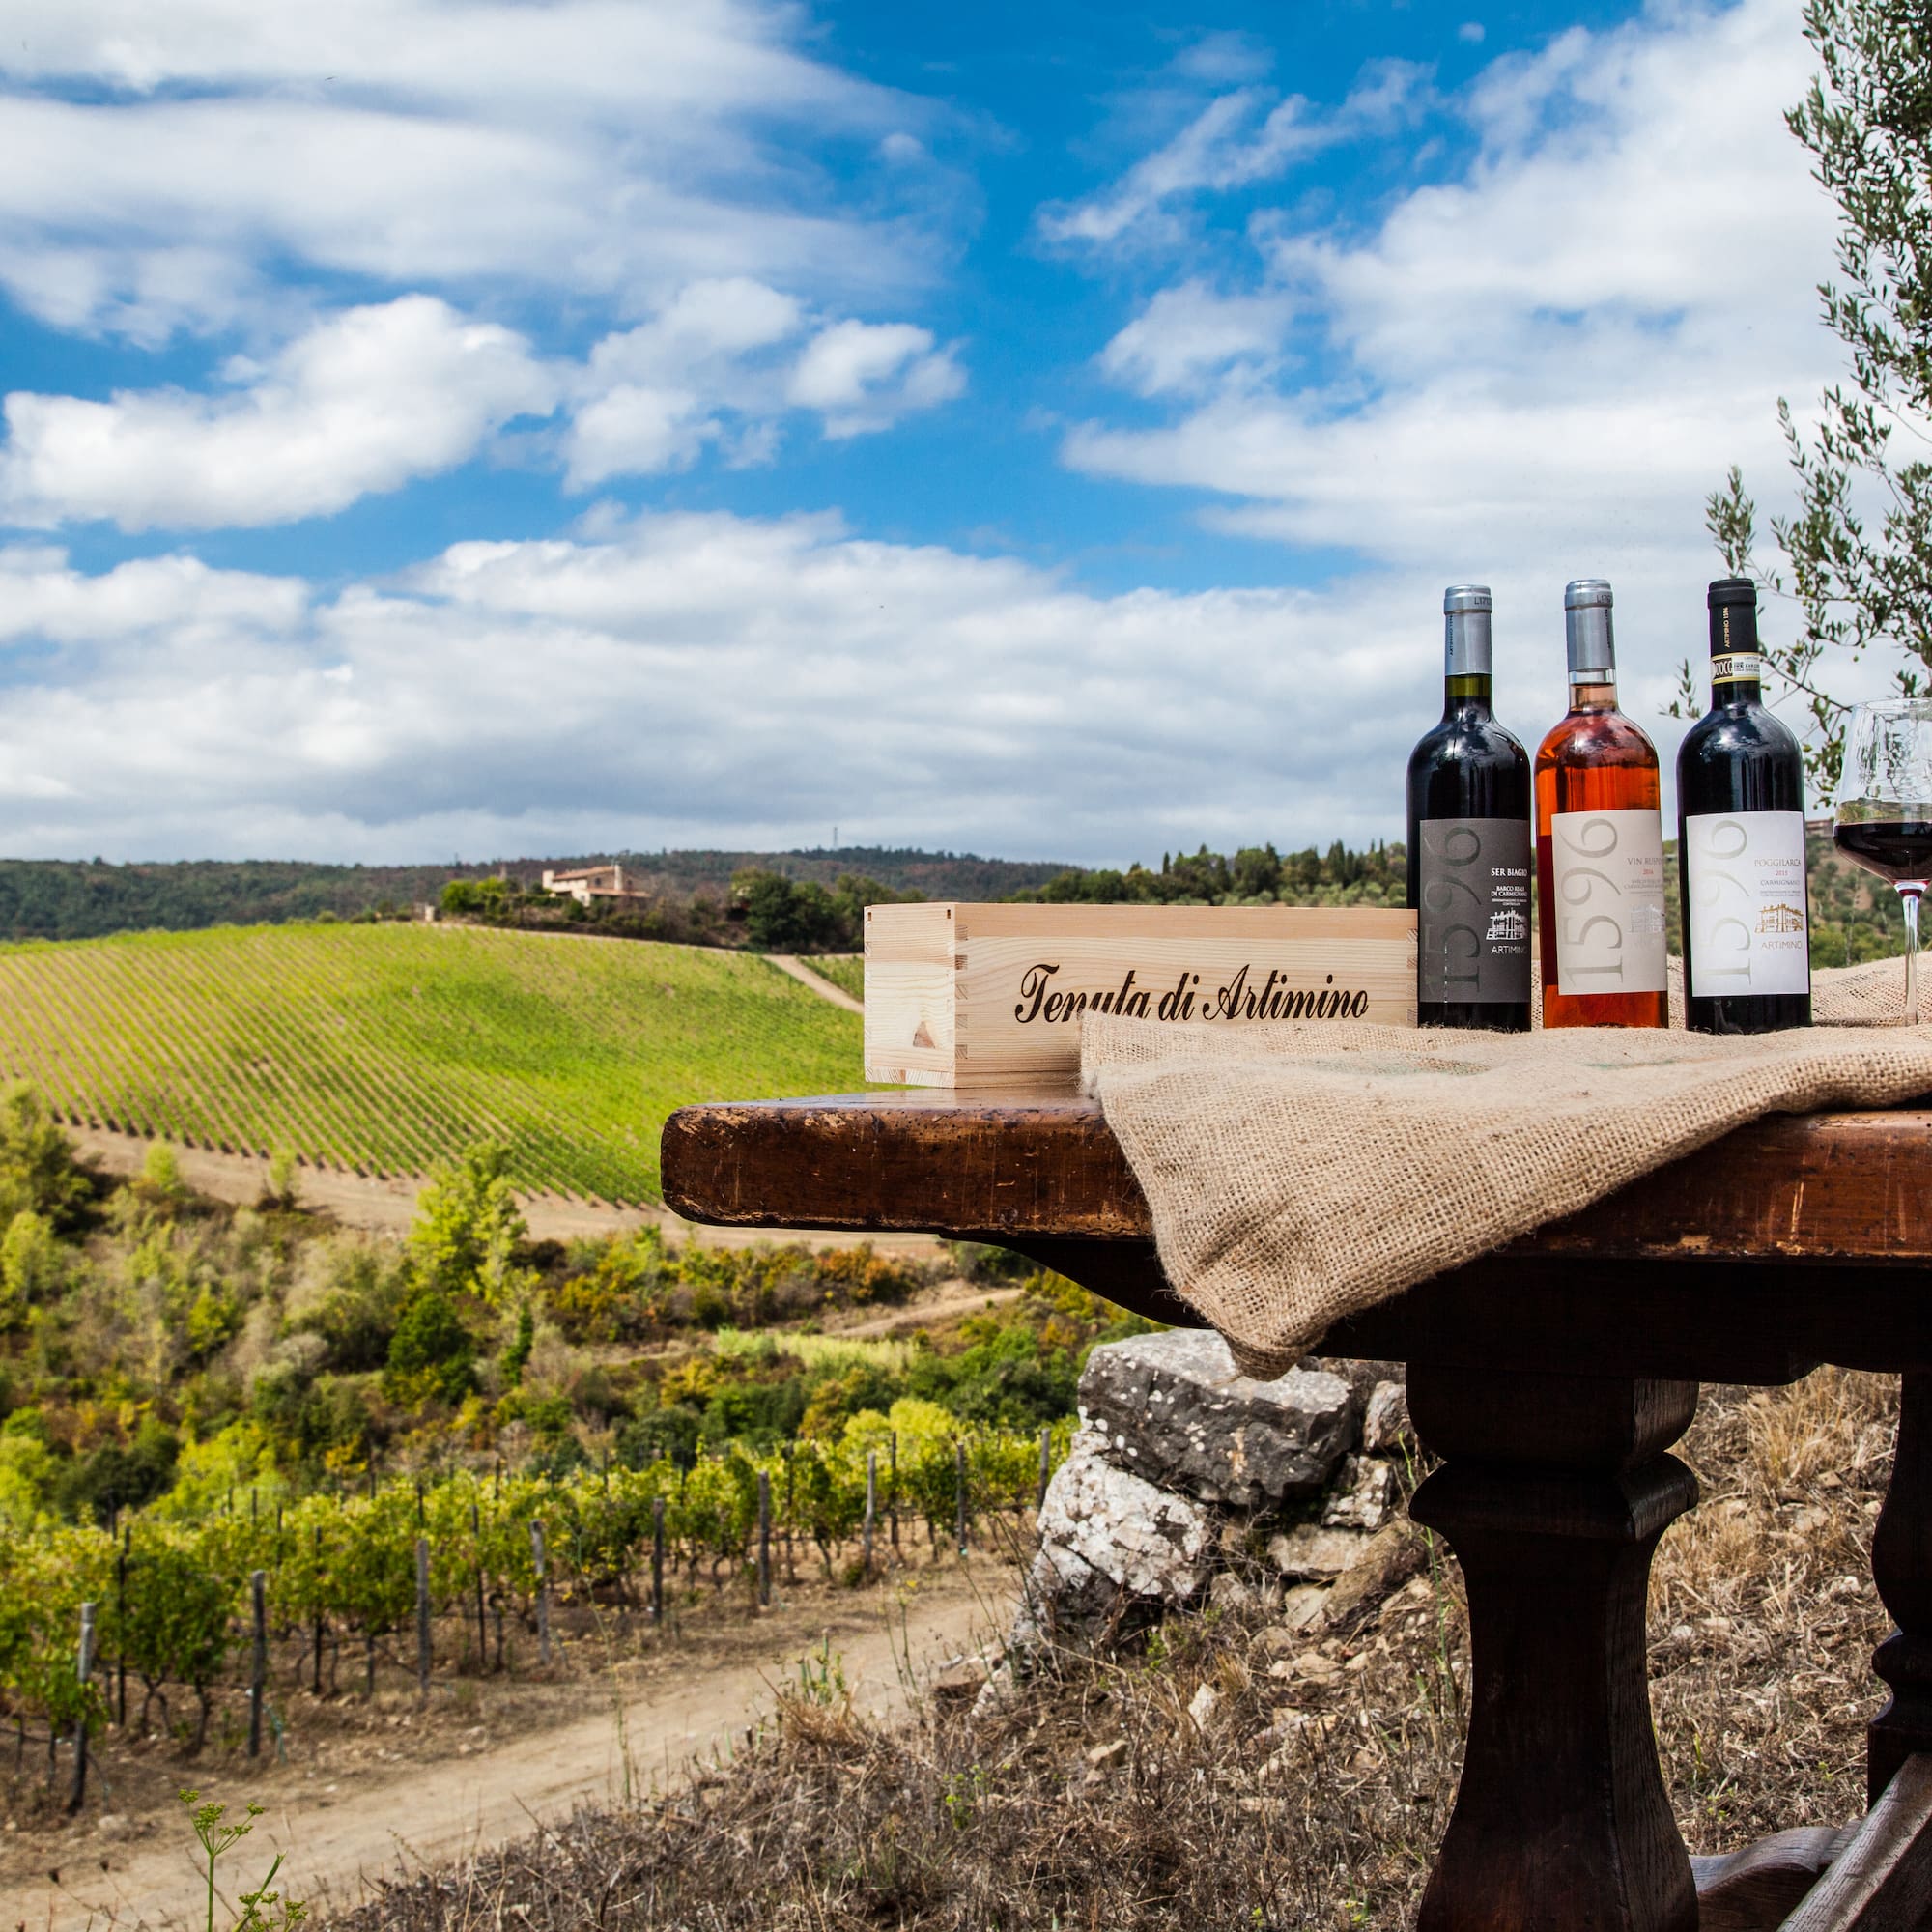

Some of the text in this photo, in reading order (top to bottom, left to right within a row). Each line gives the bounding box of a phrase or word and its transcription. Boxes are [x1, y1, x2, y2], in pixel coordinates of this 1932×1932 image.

[1491, 867, 1506, 876] SER
[1626, 857, 1643, 866] VIN
[1423, 826, 1481, 995] 1596
[1558, 817, 1623, 987] 1596
[1695, 819, 1751, 987] 1596
[1761, 941, 1803, 951] ARTIMINO
[1014, 963, 1370, 1024] Tenuta di Artimino
